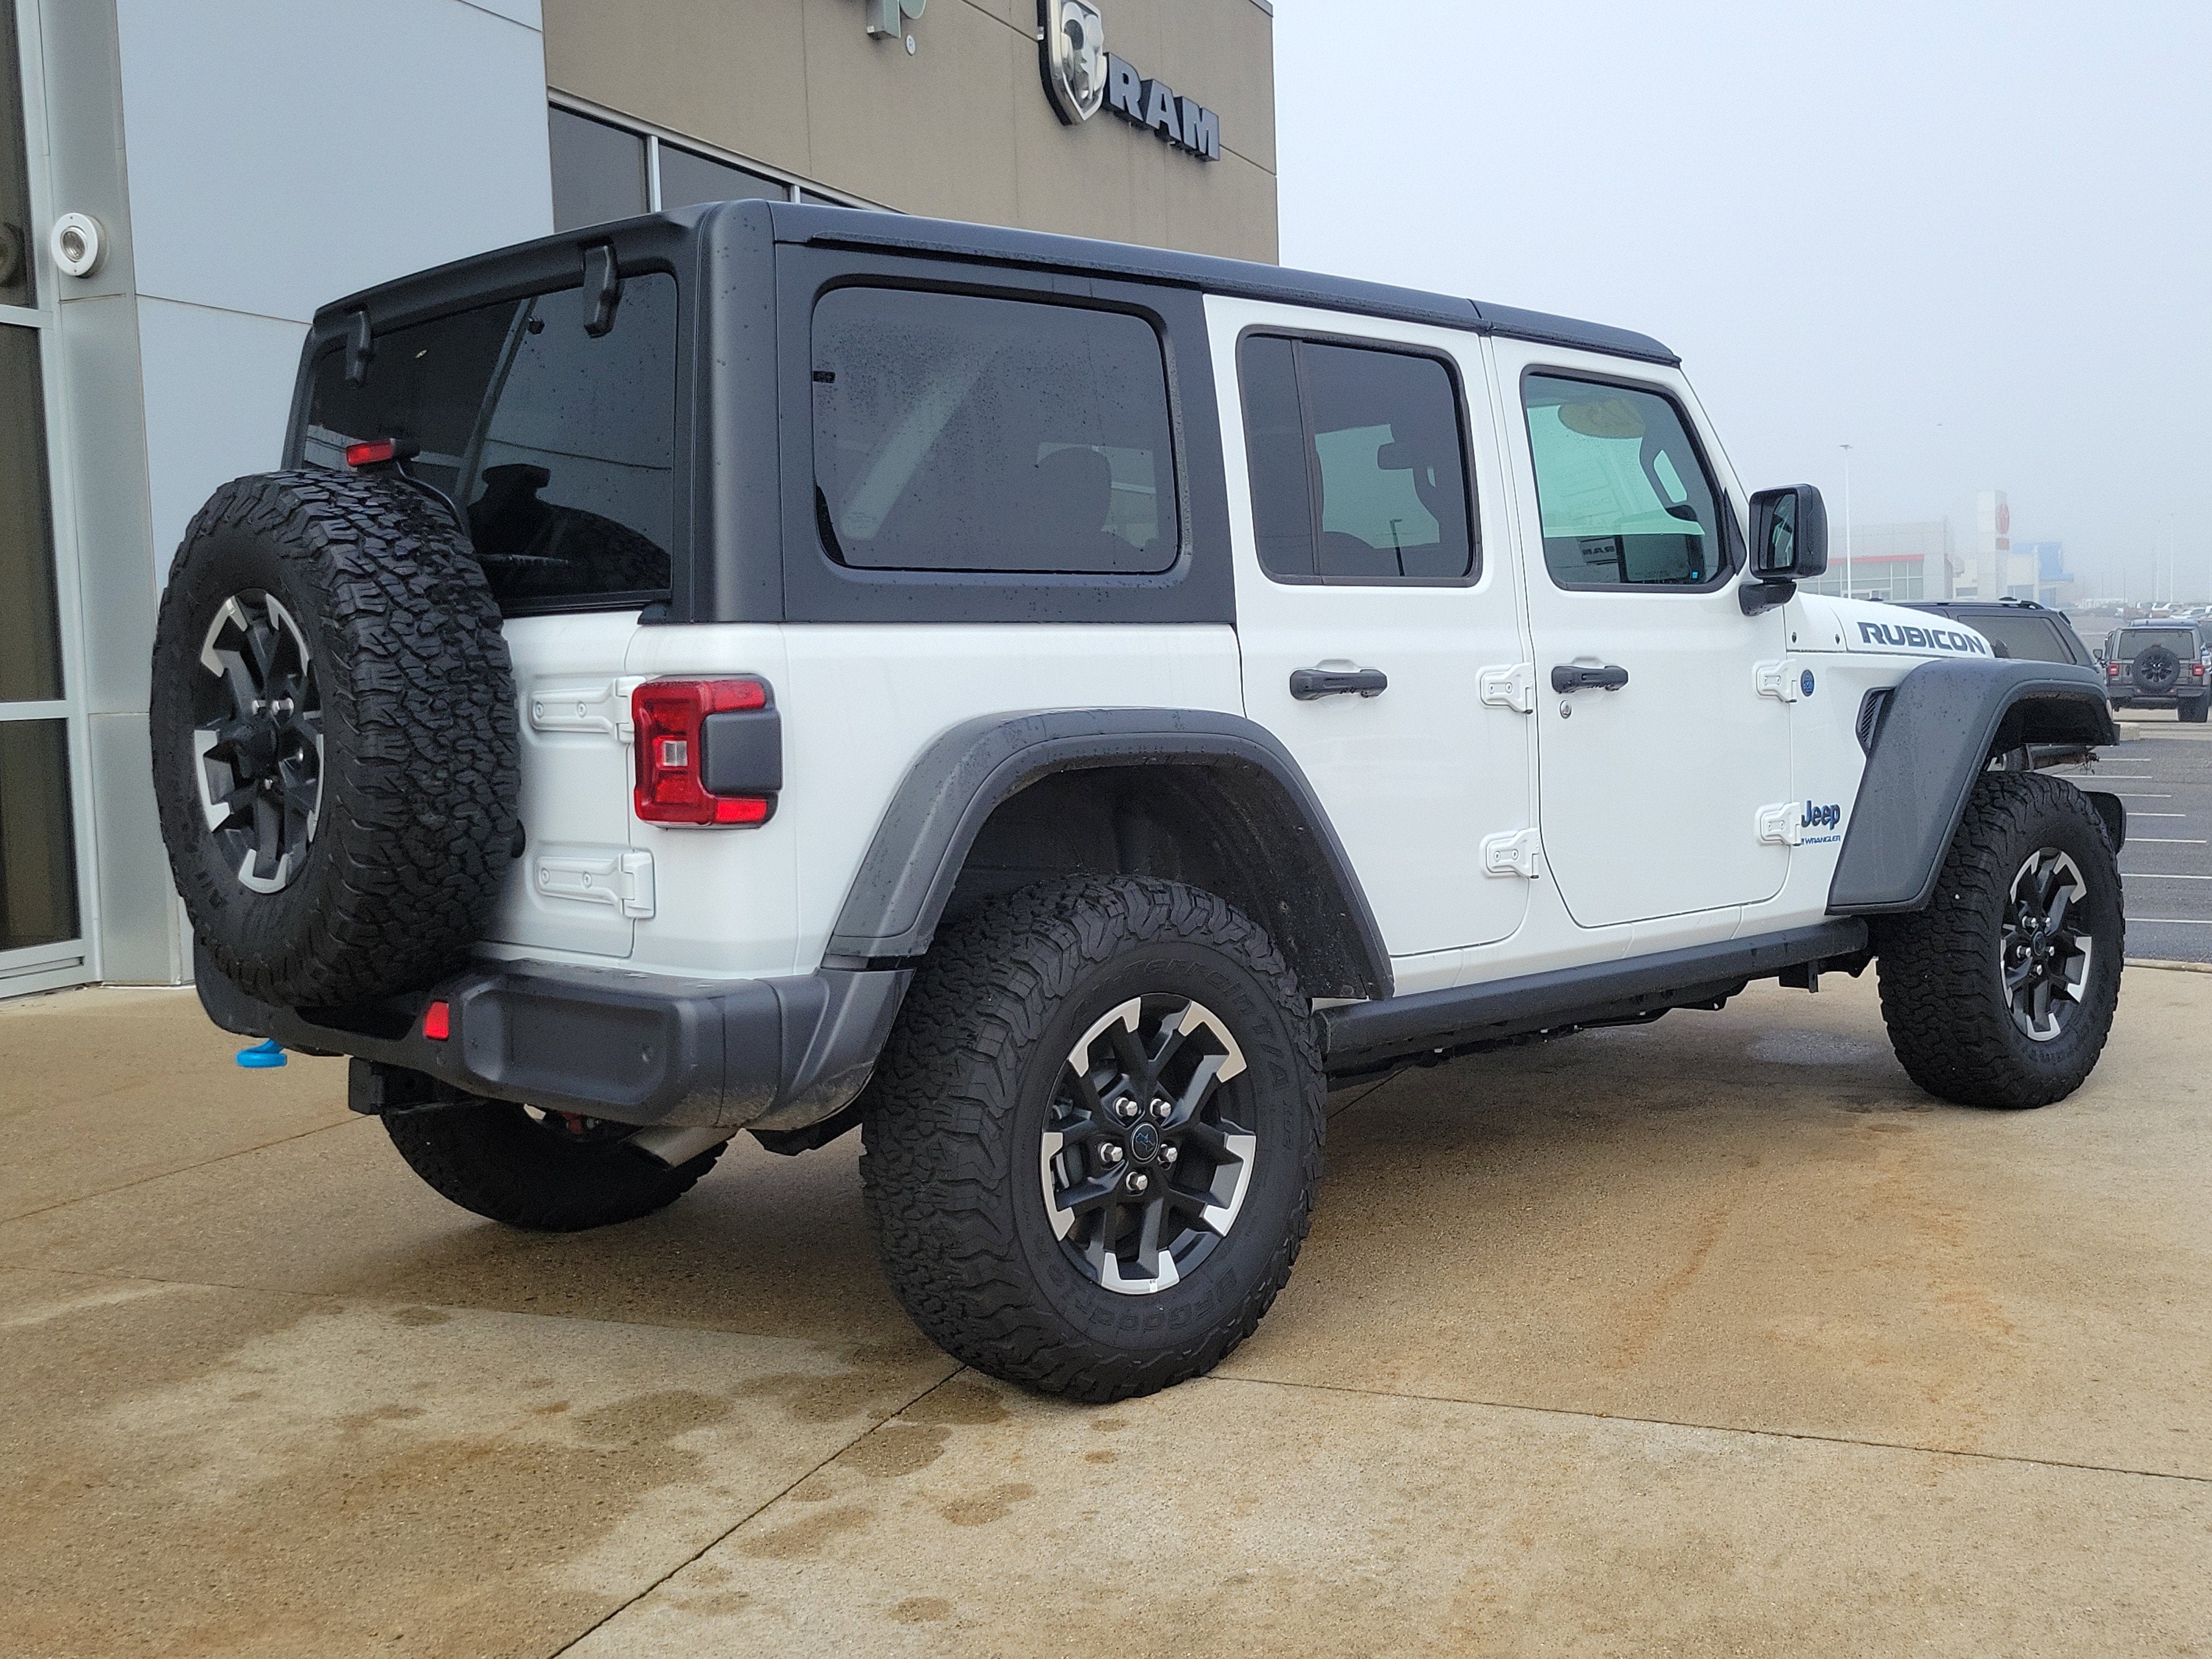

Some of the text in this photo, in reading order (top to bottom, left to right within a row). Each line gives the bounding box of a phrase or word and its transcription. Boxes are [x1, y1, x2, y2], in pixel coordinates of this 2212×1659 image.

[1105, 52, 1220, 161] RAM
[1857, 622, 1986, 654] RUBICON
[1801, 800, 1841, 831] Jeep
[1805, 835, 1841, 845] WRANGLER
